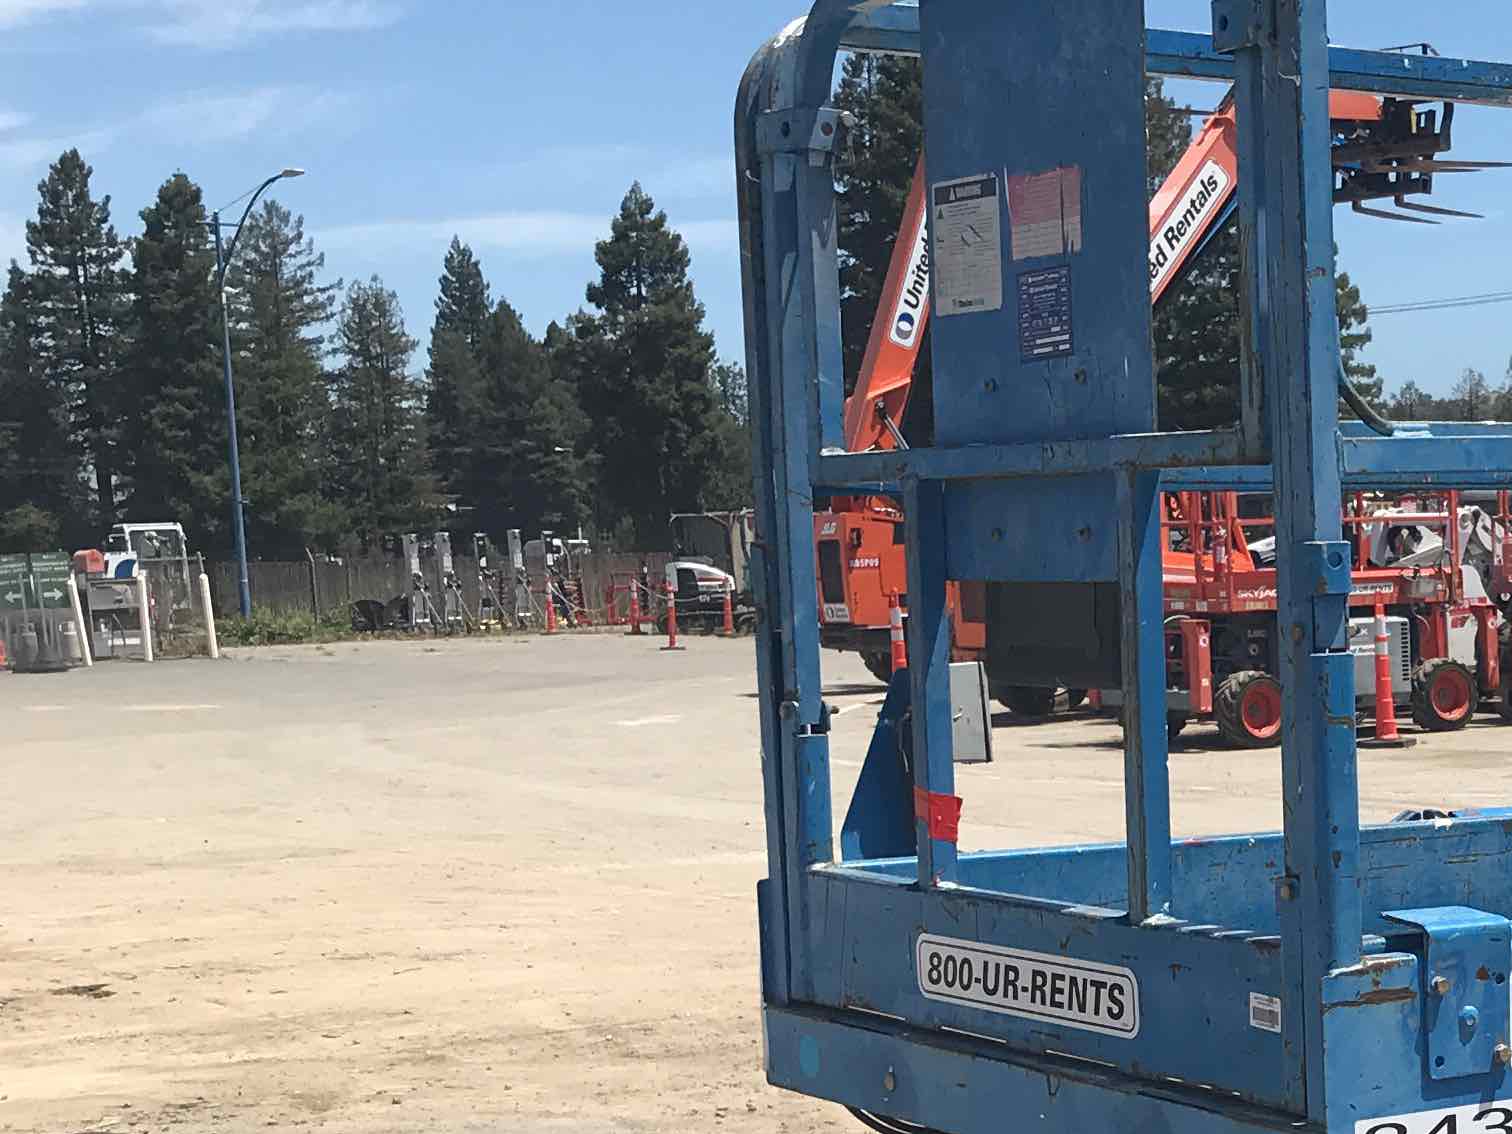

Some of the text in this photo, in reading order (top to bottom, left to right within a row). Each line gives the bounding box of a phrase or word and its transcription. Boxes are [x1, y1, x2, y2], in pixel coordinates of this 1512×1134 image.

[1163, 175, 1218, 252] Rentals
[1237, 585, 1278, 599] SKYJAC
[927, 951, 1126, 1021] 800-UR-RENTS
